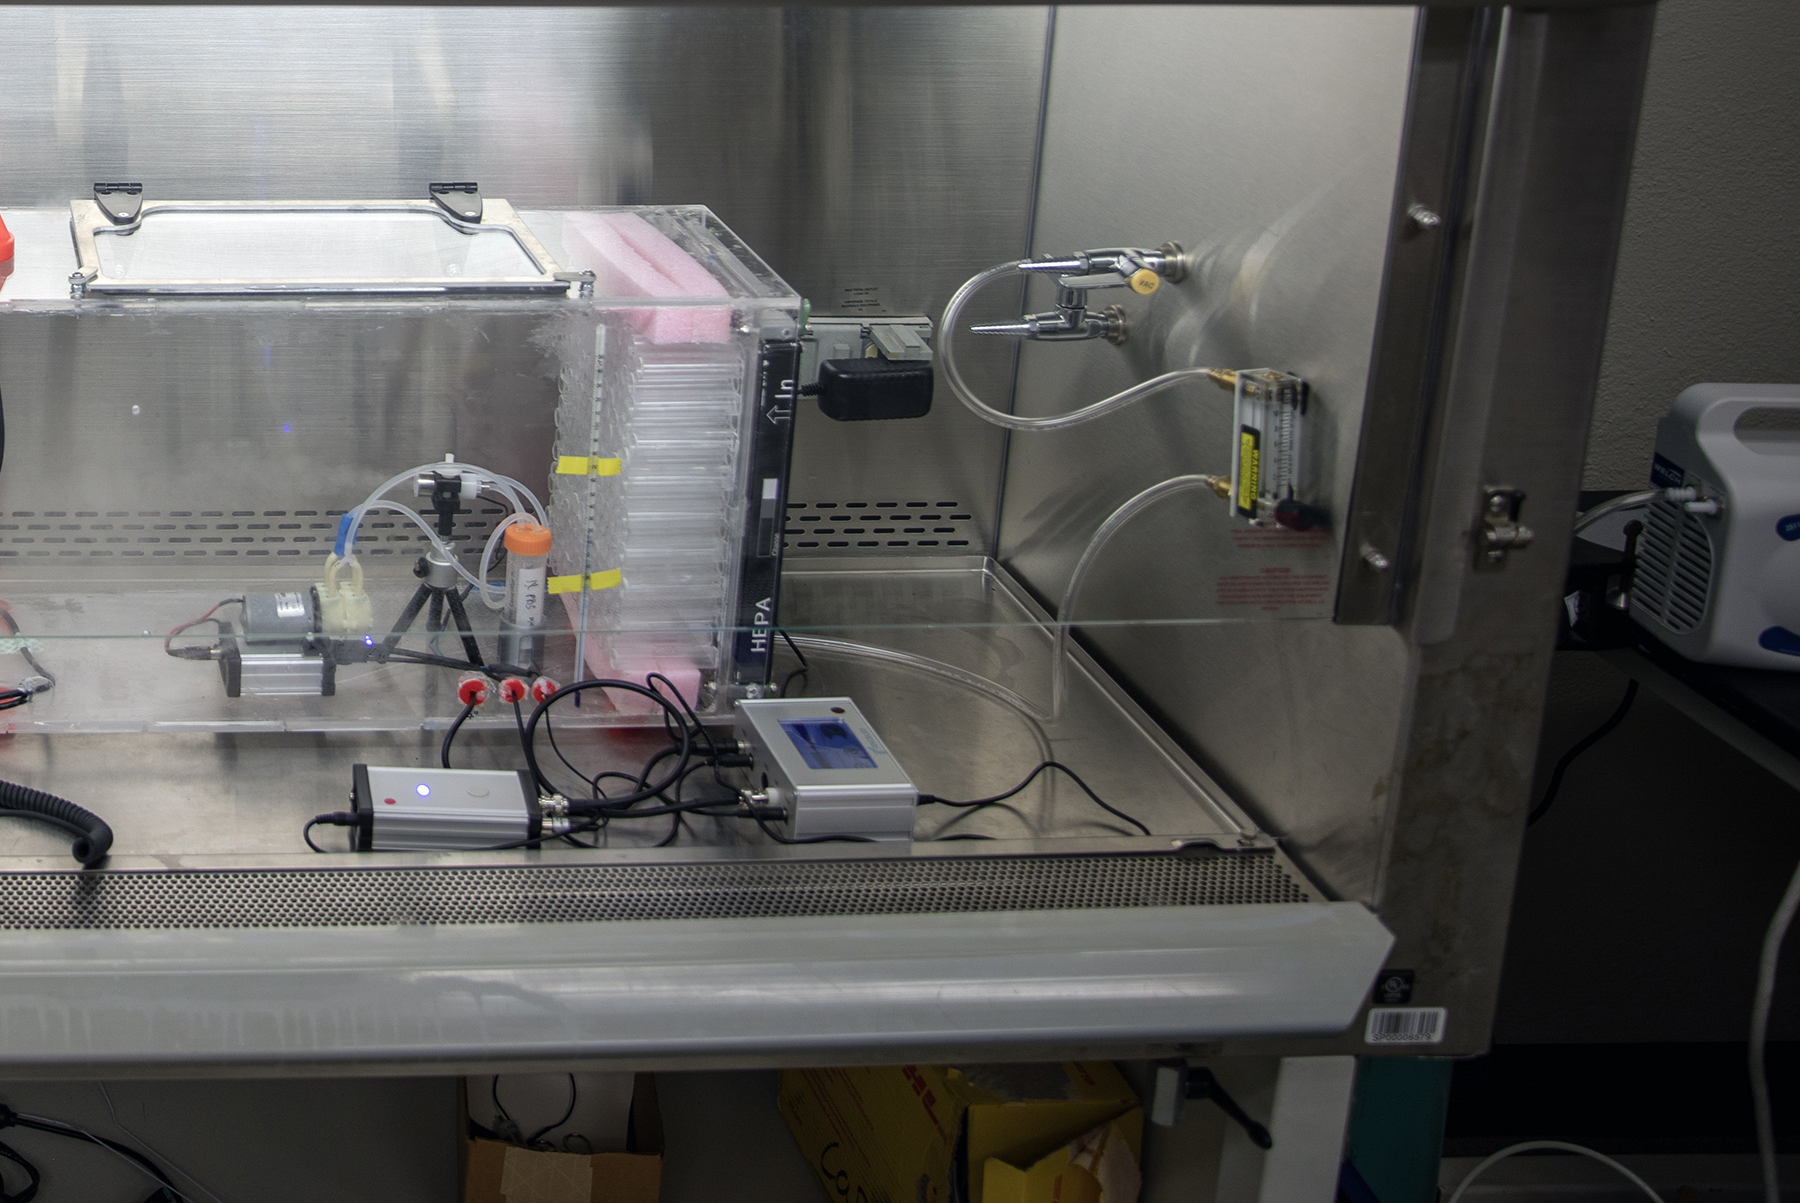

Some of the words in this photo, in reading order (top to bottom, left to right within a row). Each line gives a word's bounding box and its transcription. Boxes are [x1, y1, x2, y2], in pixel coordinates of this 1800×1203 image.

[774, 379, 796, 400] In
[1250, 449, 1260, 502] WARNING
[1654, 462, 1682, 485] WELCH
[525, 594, 537, 610] PBS
[750, 596, 772, 653] HEPA
